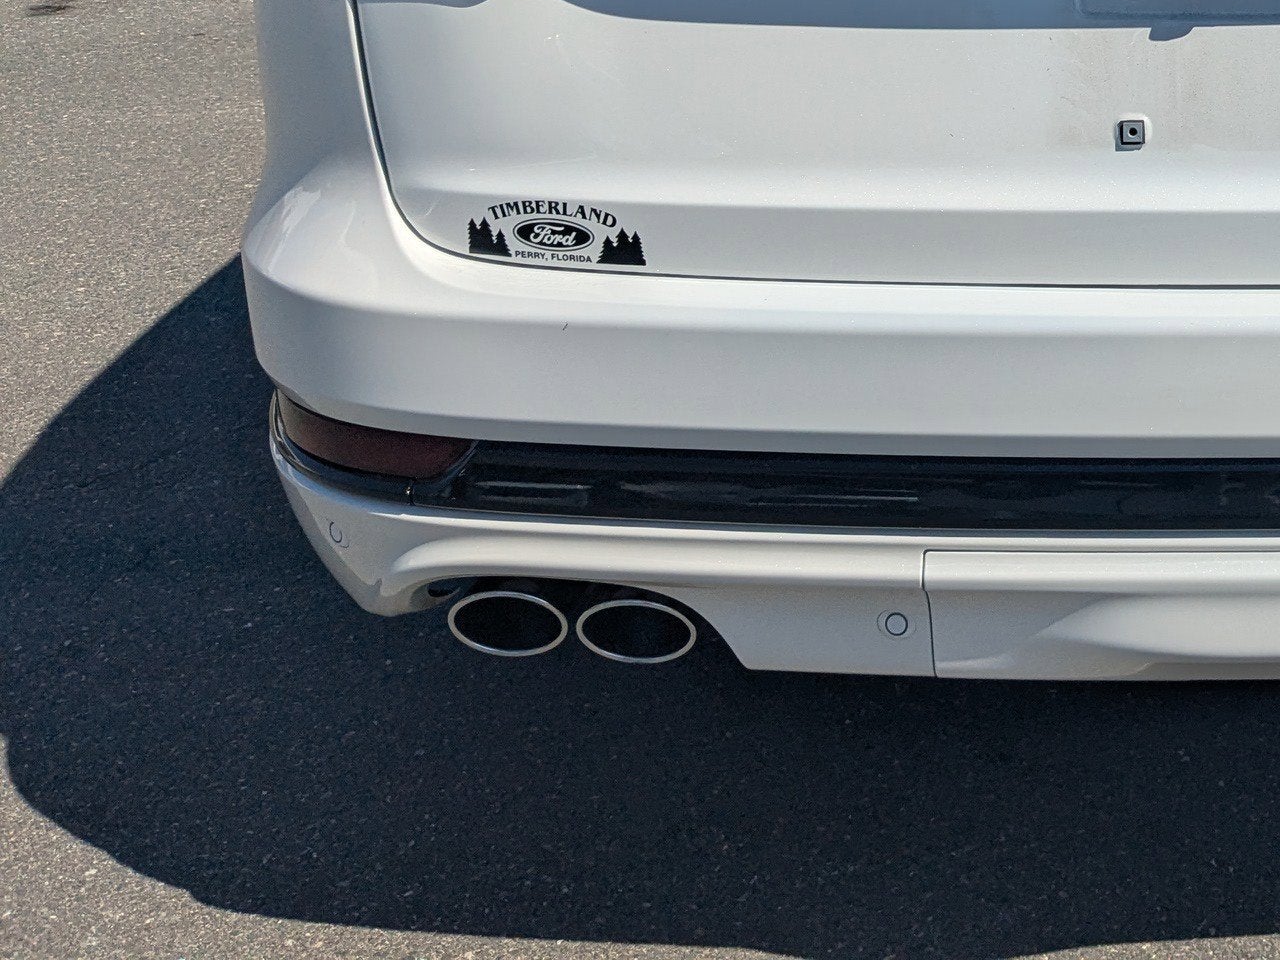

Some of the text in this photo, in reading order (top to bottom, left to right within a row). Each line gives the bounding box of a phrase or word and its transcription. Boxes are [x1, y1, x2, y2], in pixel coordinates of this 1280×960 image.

[488, 200, 618, 229] TIMBERLAND
[529, 223, 578, 247] Ford
[514, 250, 593, 263] PERRY, FLORIDA
